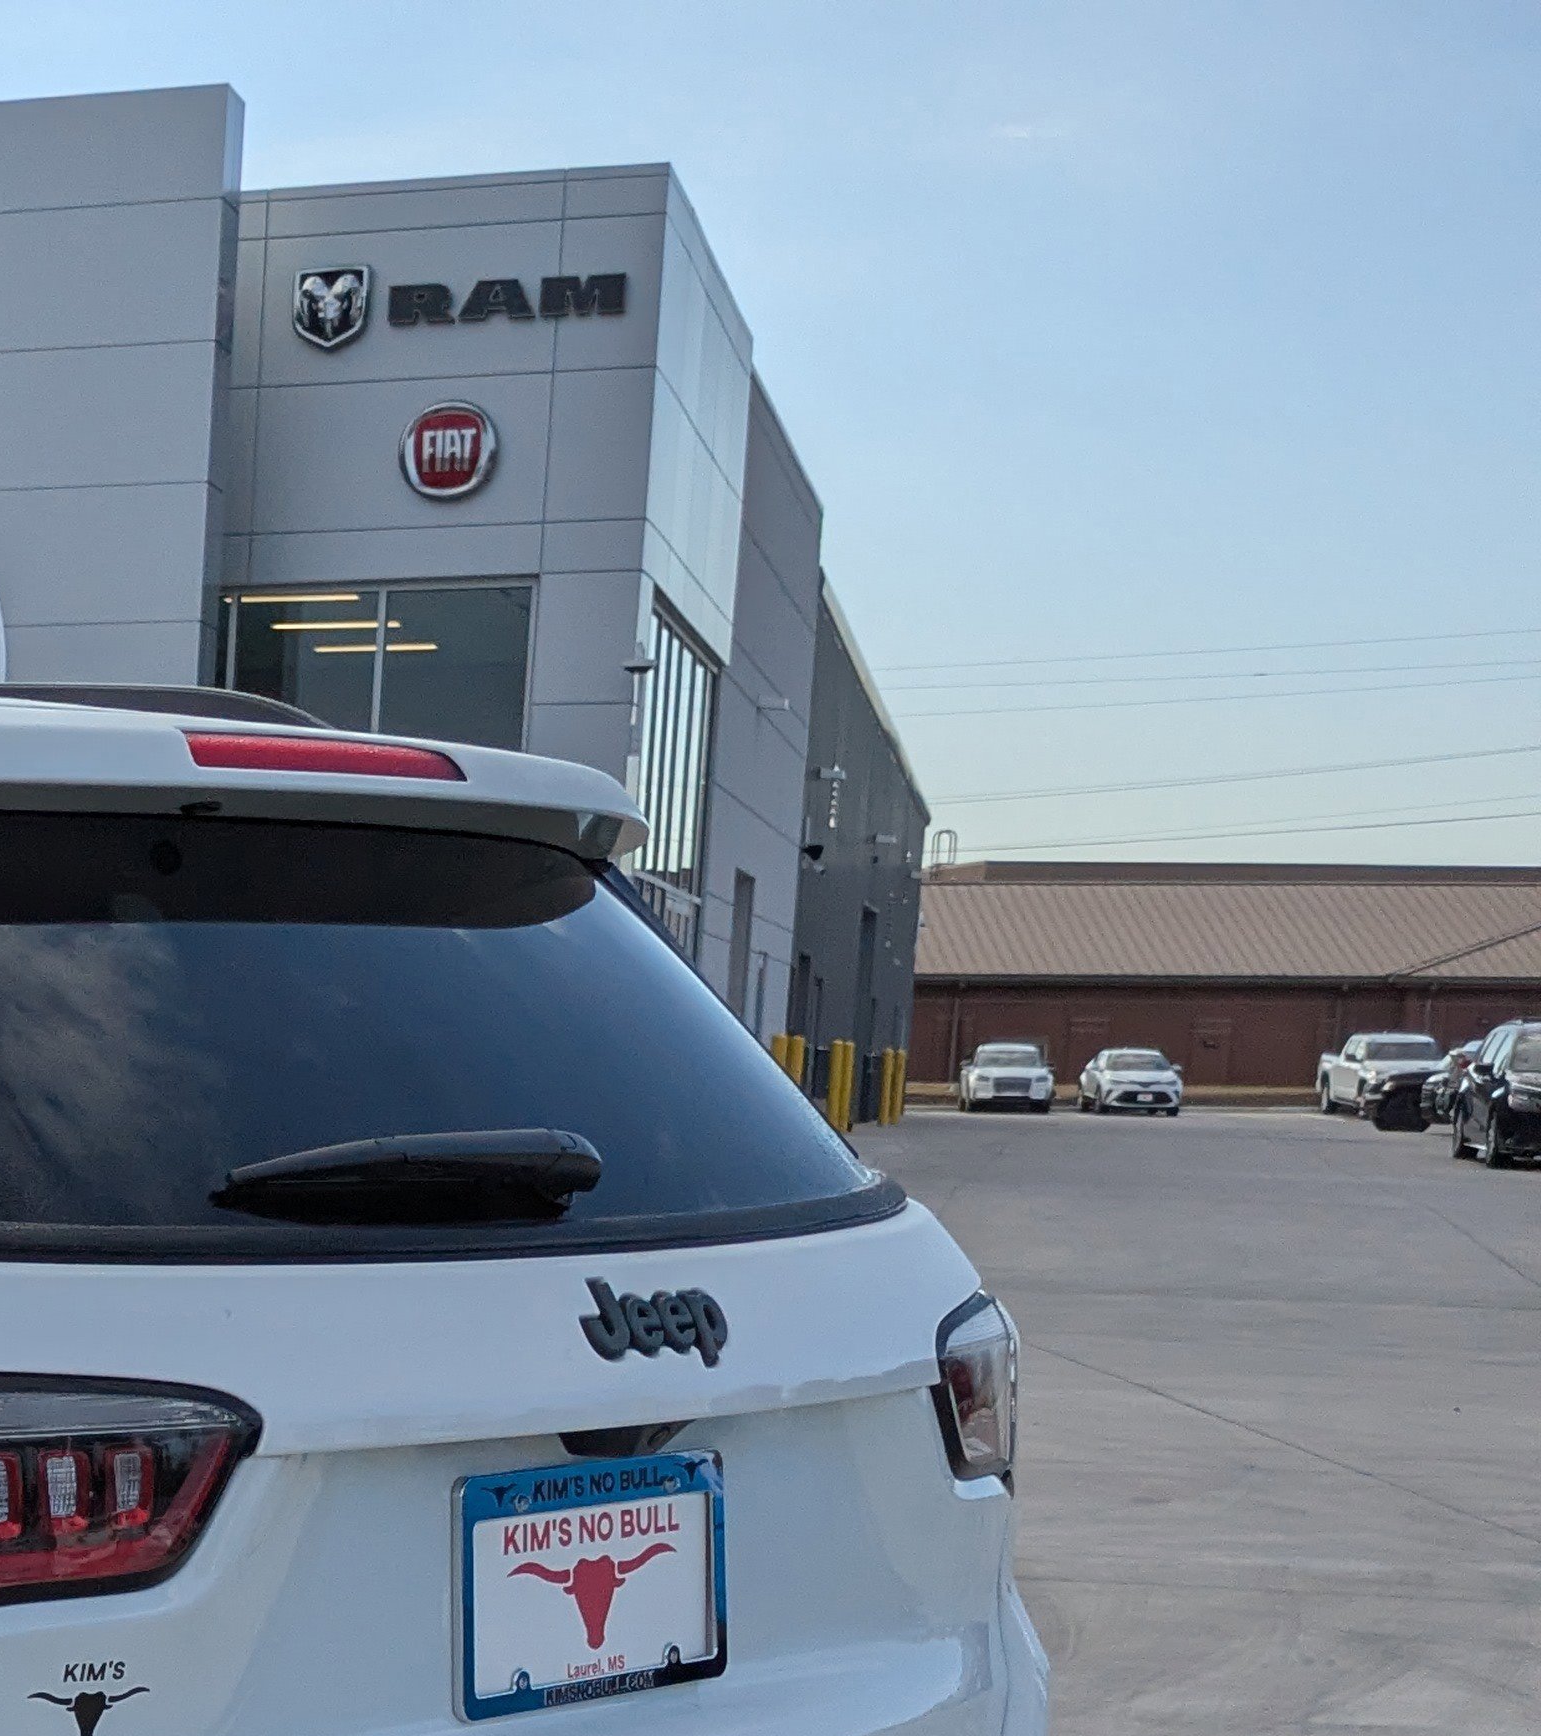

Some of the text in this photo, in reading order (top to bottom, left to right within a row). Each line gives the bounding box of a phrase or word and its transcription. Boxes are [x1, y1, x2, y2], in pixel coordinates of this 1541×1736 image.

[387, 272, 628, 327] RAM
[420, 426, 477, 473] FIAT
[578, 1276, 728, 1368] Jeep
[532, 1466, 660, 1502] KIM'S NO BULL
[503, 1503, 680, 1555] KIM'S NO BULL
[63, 1661, 126, 1683] KIM'S
[607, 1654, 626, 1672] MS
